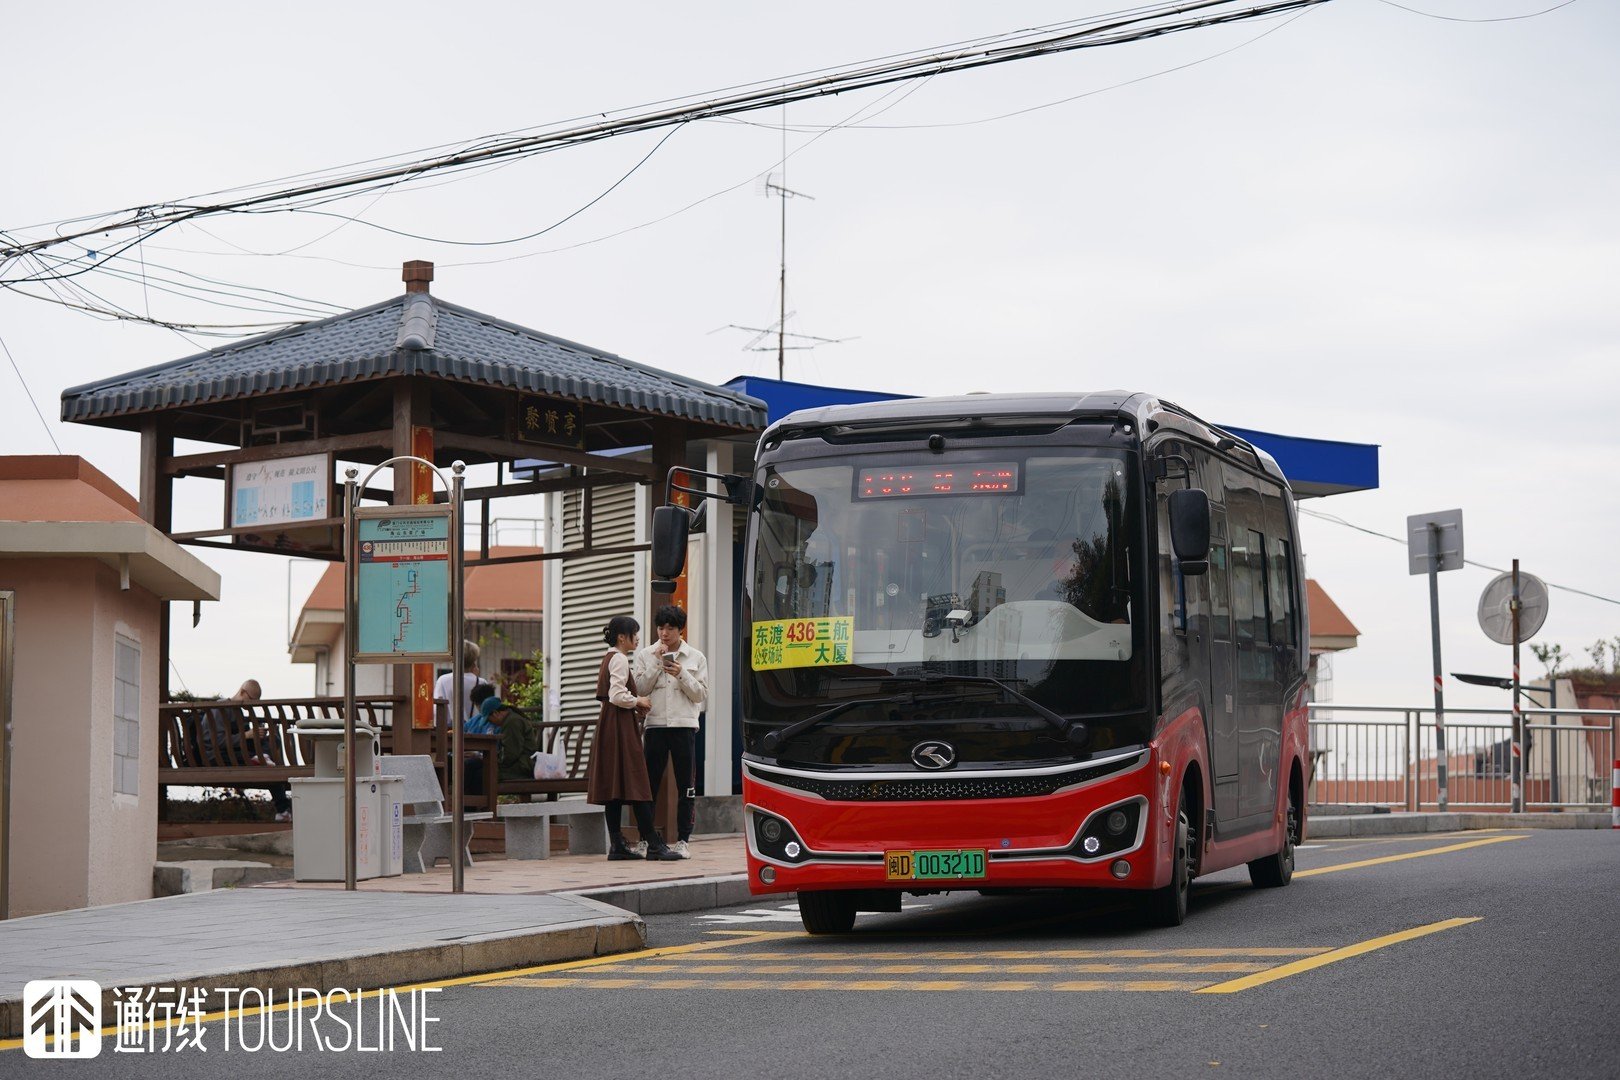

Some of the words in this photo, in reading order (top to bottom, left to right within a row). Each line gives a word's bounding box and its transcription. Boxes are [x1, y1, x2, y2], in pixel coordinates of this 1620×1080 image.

[755, 624, 784, 647] 东渡
[786, 621, 815, 643] 436
[815, 620, 850, 641] 三航
[754, 646, 783, 666] 公交场站
[815, 642, 848, 664] 大厦
